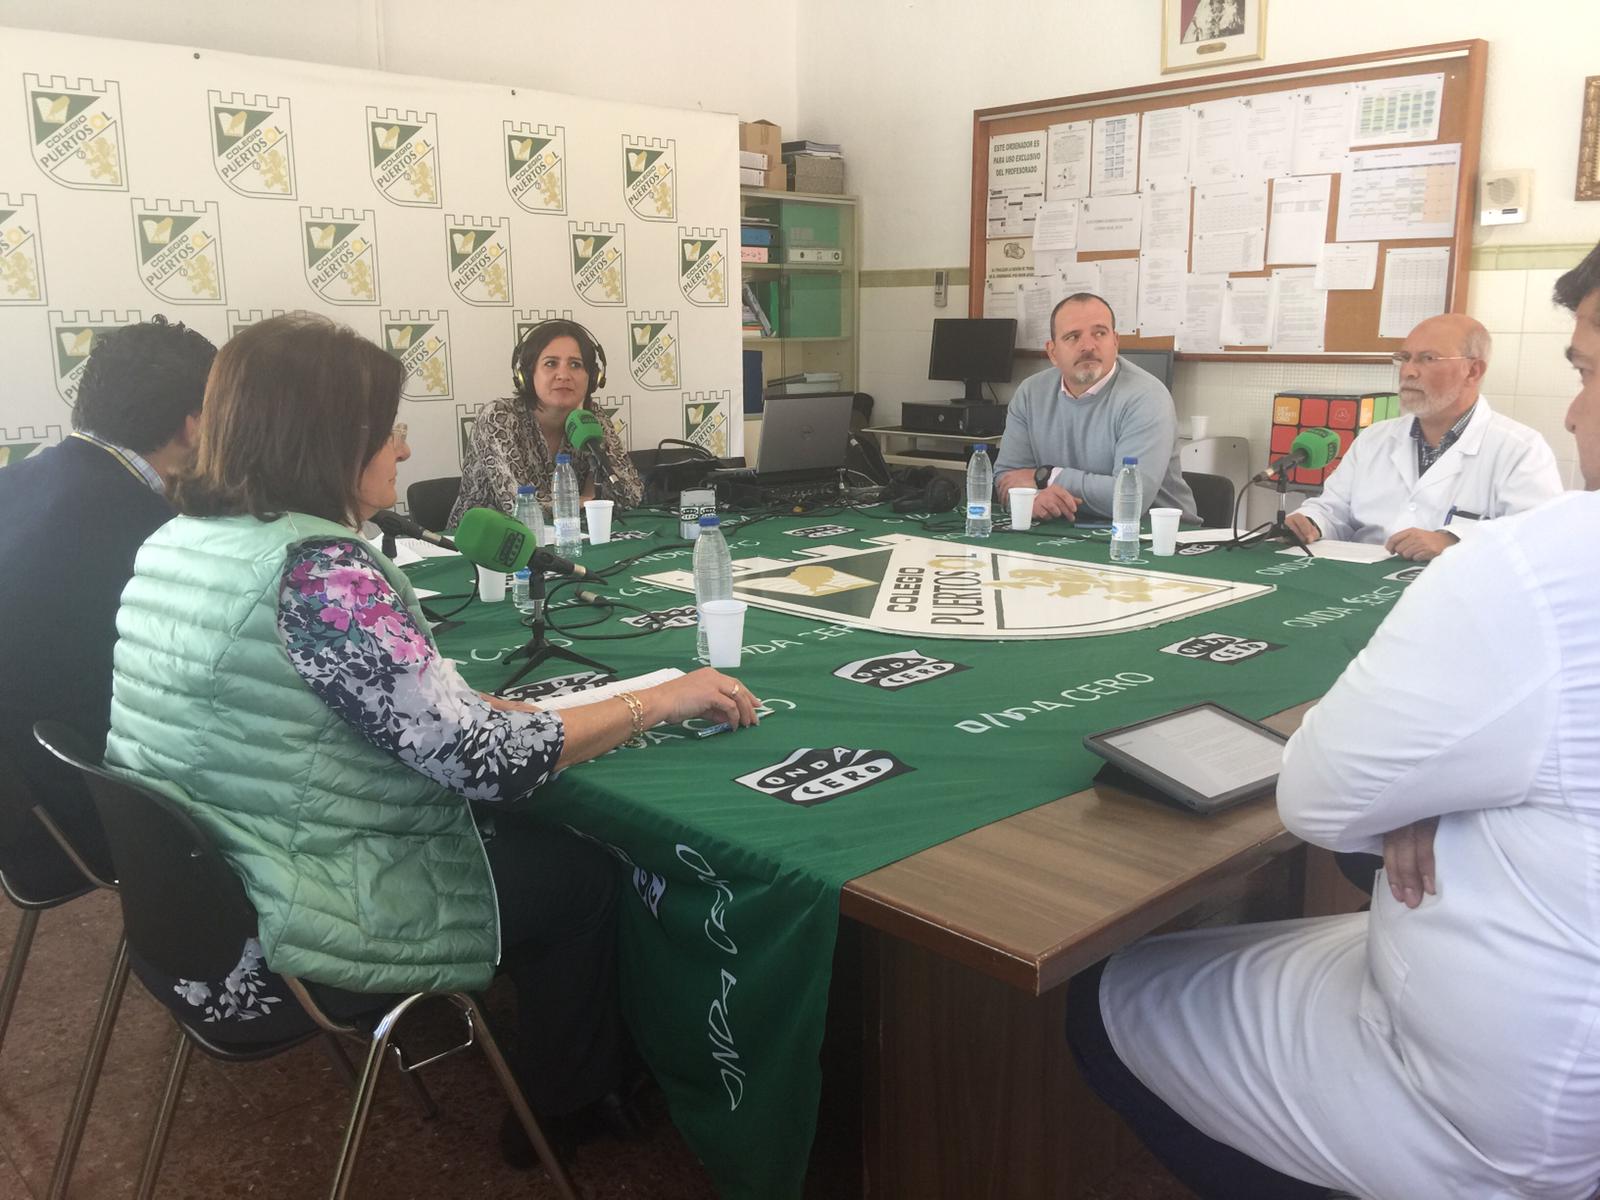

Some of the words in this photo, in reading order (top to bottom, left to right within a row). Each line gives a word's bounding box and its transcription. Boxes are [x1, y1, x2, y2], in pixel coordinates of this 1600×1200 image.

[45, 115, 87, 149] COLEGIO
[225, 128, 263, 160] COLEGIO
[993, 144, 1005, 152] ESTE
[1030, 140, 1039, 148] ES
[381, 142, 413, 171] COLEGIO
[515, 154, 543, 181] COLEGIO
[993, 156, 1005, 164] PARA
[1005, 154, 1015, 163] USO
[1016, 153, 1041, 162] EXCLUSIVO
[631, 165, 657, 191] COLEGIO
[996, 168, 1005, 176] DEL
[150, 234, 188, 268] COLEGIO
[317, 240, 349, 271] COLEGIO
[458, 246, 487, 275] COLEGIO
[580, 250, 604, 277] COLEGIO
[686, 254, 710, 280] COLEGIO
[637, 337, 660, 363] COLEGIO
[886, 567, 925, 613] COLEGIO
[1282, 606, 1362, 628] ONDA
[857, 659, 921, 679] ONDA
[887, 664, 946, 684] CERO
[1061, 672, 1154, 701] CERO
[765, 746, 850, 785] ONDA
[802, 765, 882, 795] CERO
[709, 968, 746, 1112] ONDA
